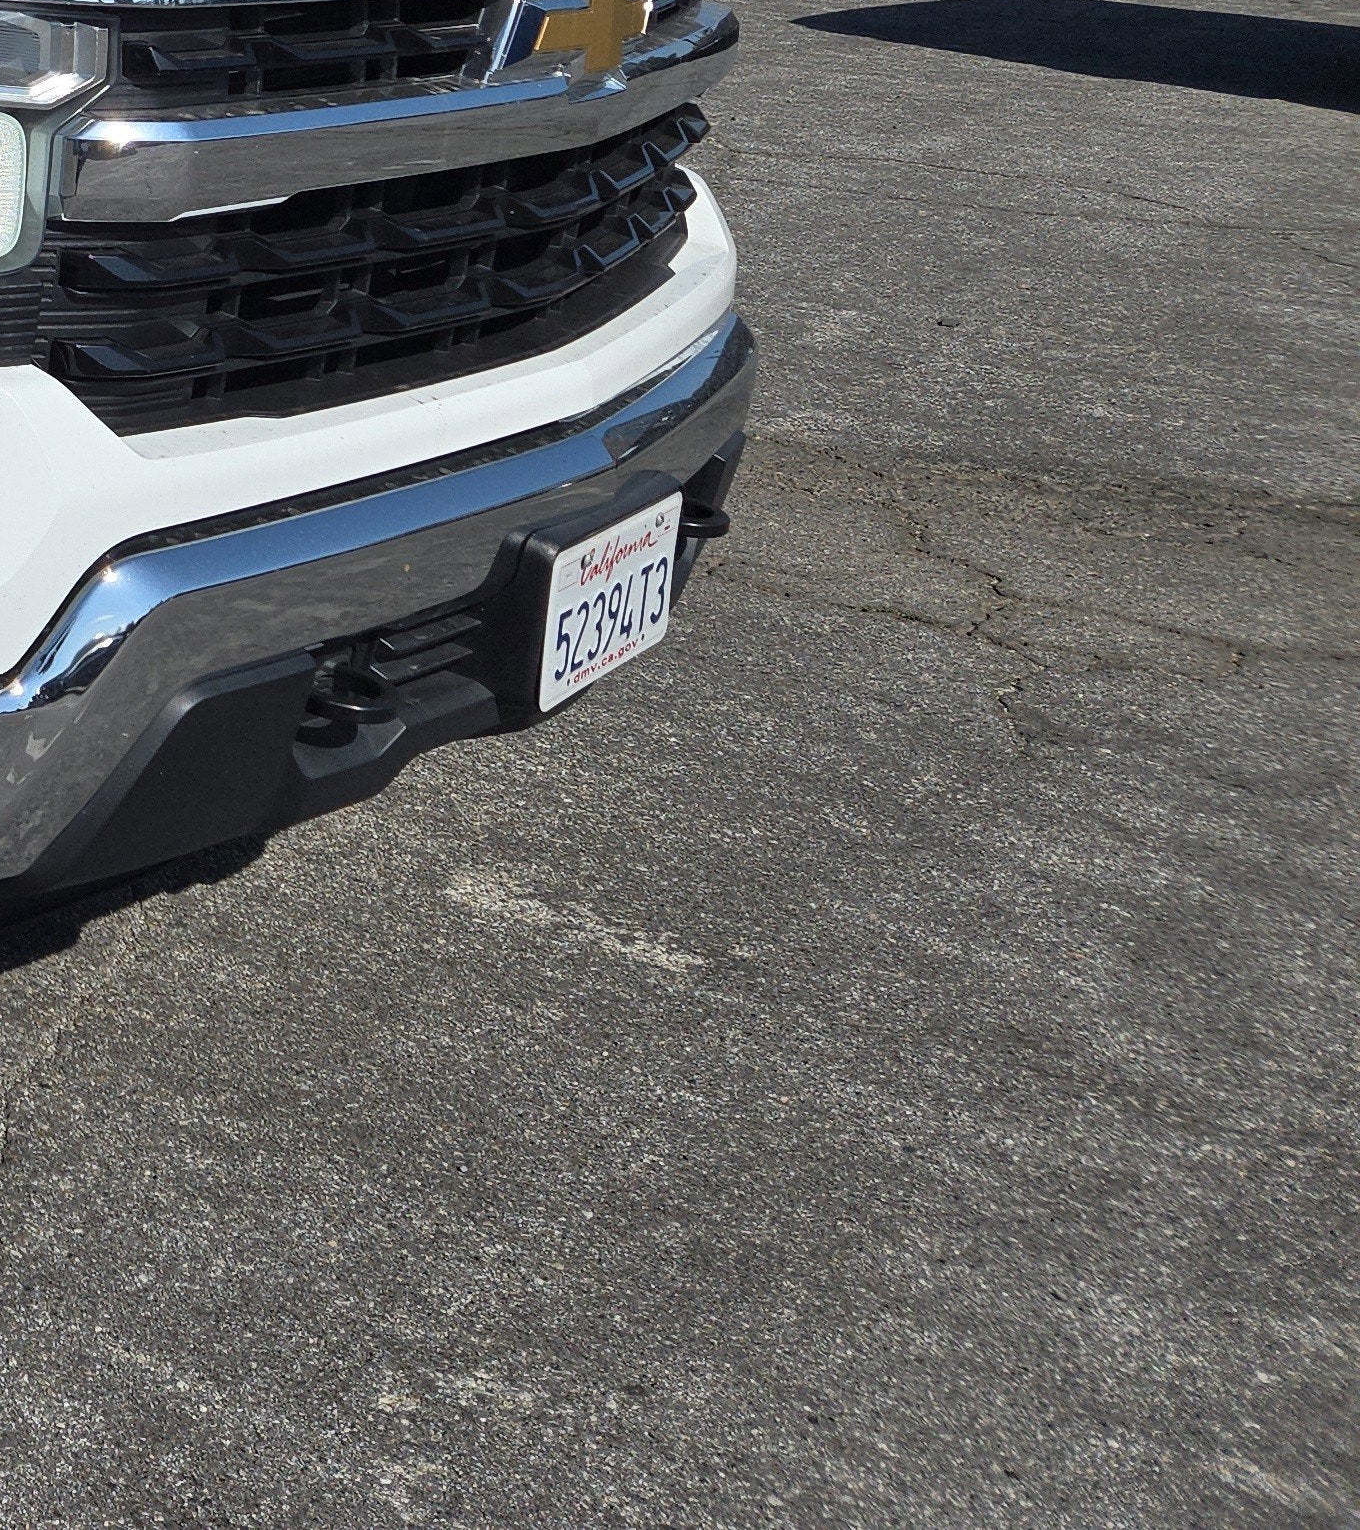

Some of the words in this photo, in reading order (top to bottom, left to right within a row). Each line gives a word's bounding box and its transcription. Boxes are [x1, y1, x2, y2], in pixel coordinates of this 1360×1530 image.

[580, 530, 658, 587] California
[554, 556, 669, 681] 52394T3
[573, 638, 639, 684] dmv.ca.gov
